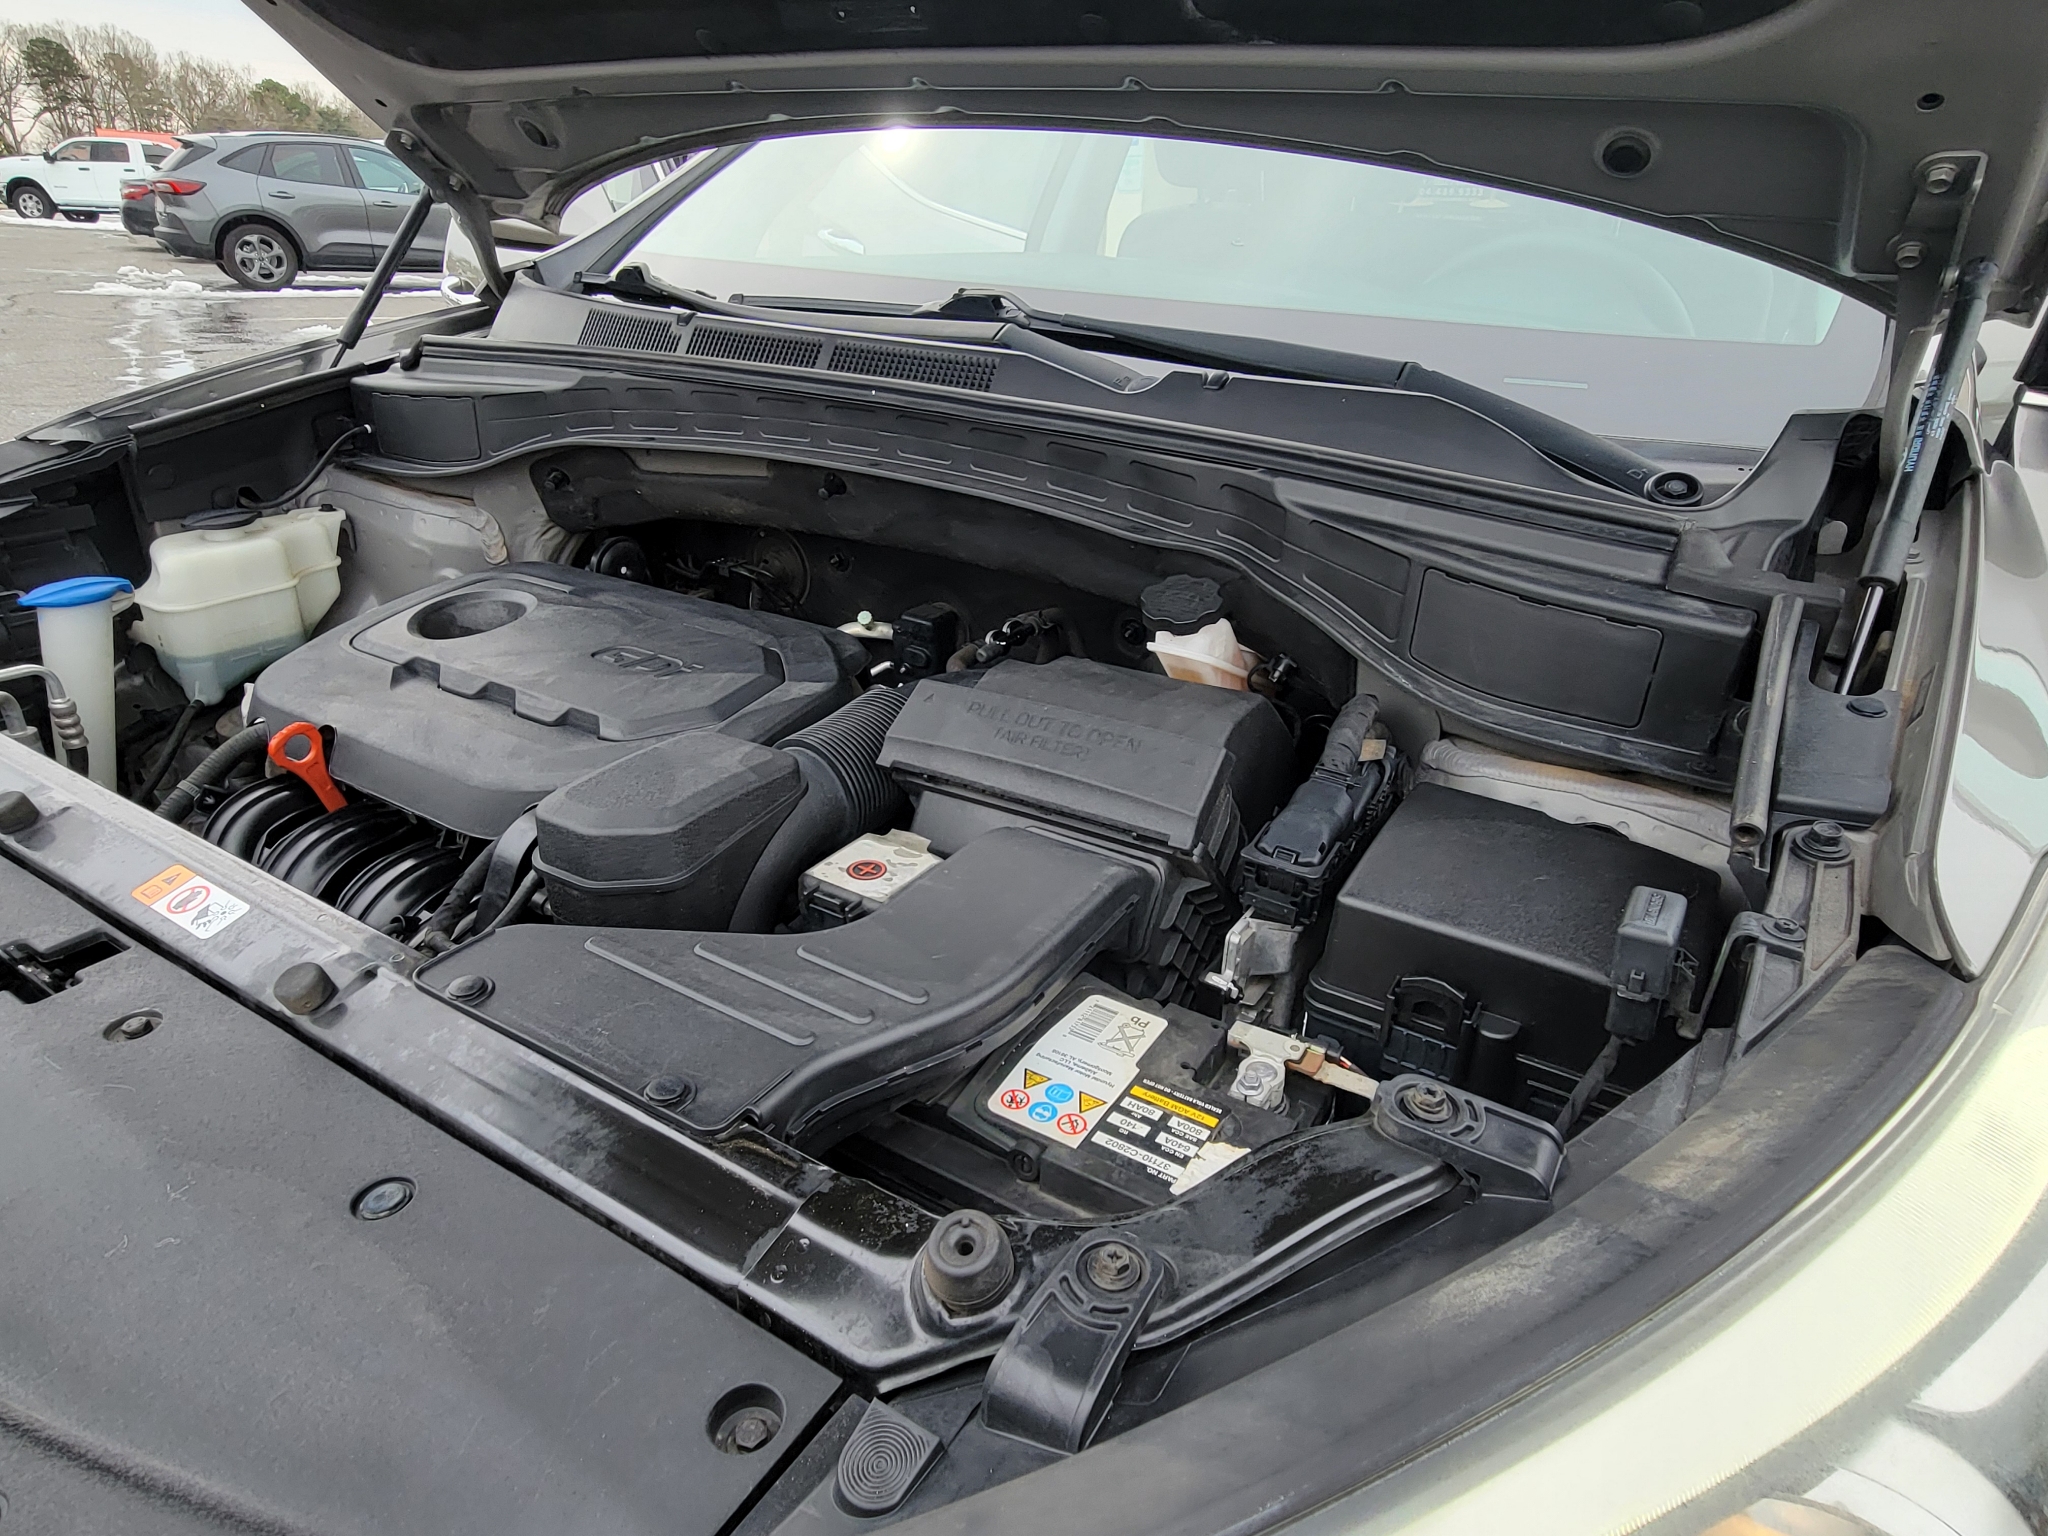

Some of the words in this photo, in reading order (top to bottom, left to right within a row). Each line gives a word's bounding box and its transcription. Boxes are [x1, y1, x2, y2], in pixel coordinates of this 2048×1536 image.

[1904, 437, 1924, 473] HYUNDAI
[966, 701, 1011, 724] PULL
[1014, 711, 1056, 731] OUT
[1059, 720, 1082, 739] TO
[1086, 728, 1142, 753] OPEN
[1130, 1016, 1151, 1029] Pb
[1127, 1100, 1156, 1116] 80AH
[1142, 1092, 1170, 1108] Battery
[1171, 1104, 1190, 1114] AGM
[1191, 1112, 1205, 1121] 12V
[1119, 1118, 1137, 1130] 140
[1176, 1120, 1203, 1136] 800A
[1165, 1136, 1191, 1152] 640A
[1105, 1138, 1171, 1171] 37110-C2802
[1158, 1173, 1178, 1184] PART
